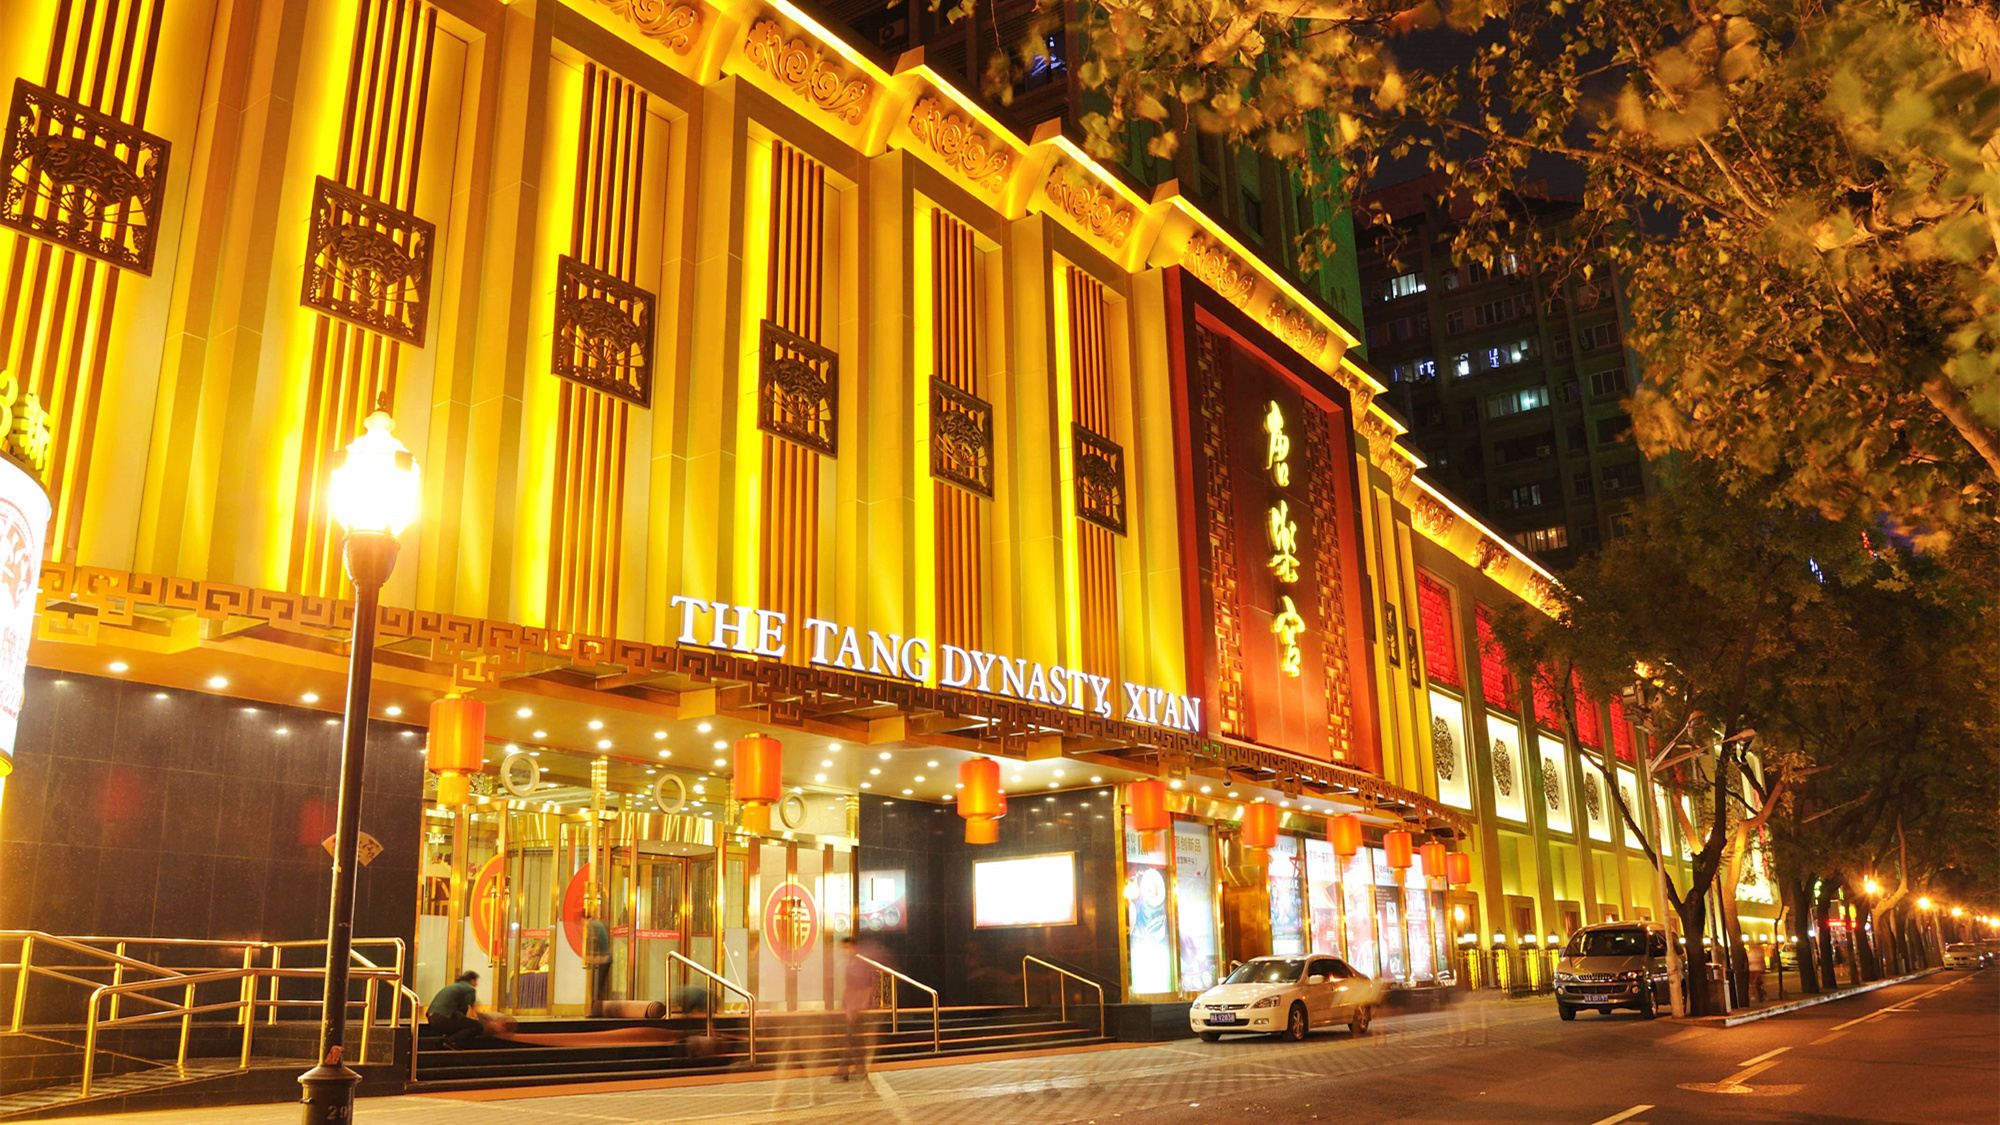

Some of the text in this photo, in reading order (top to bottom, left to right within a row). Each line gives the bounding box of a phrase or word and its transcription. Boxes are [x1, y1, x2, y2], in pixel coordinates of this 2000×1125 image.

[671, 594, 1201, 733] THE TANG DYNASTY, XI'AN
